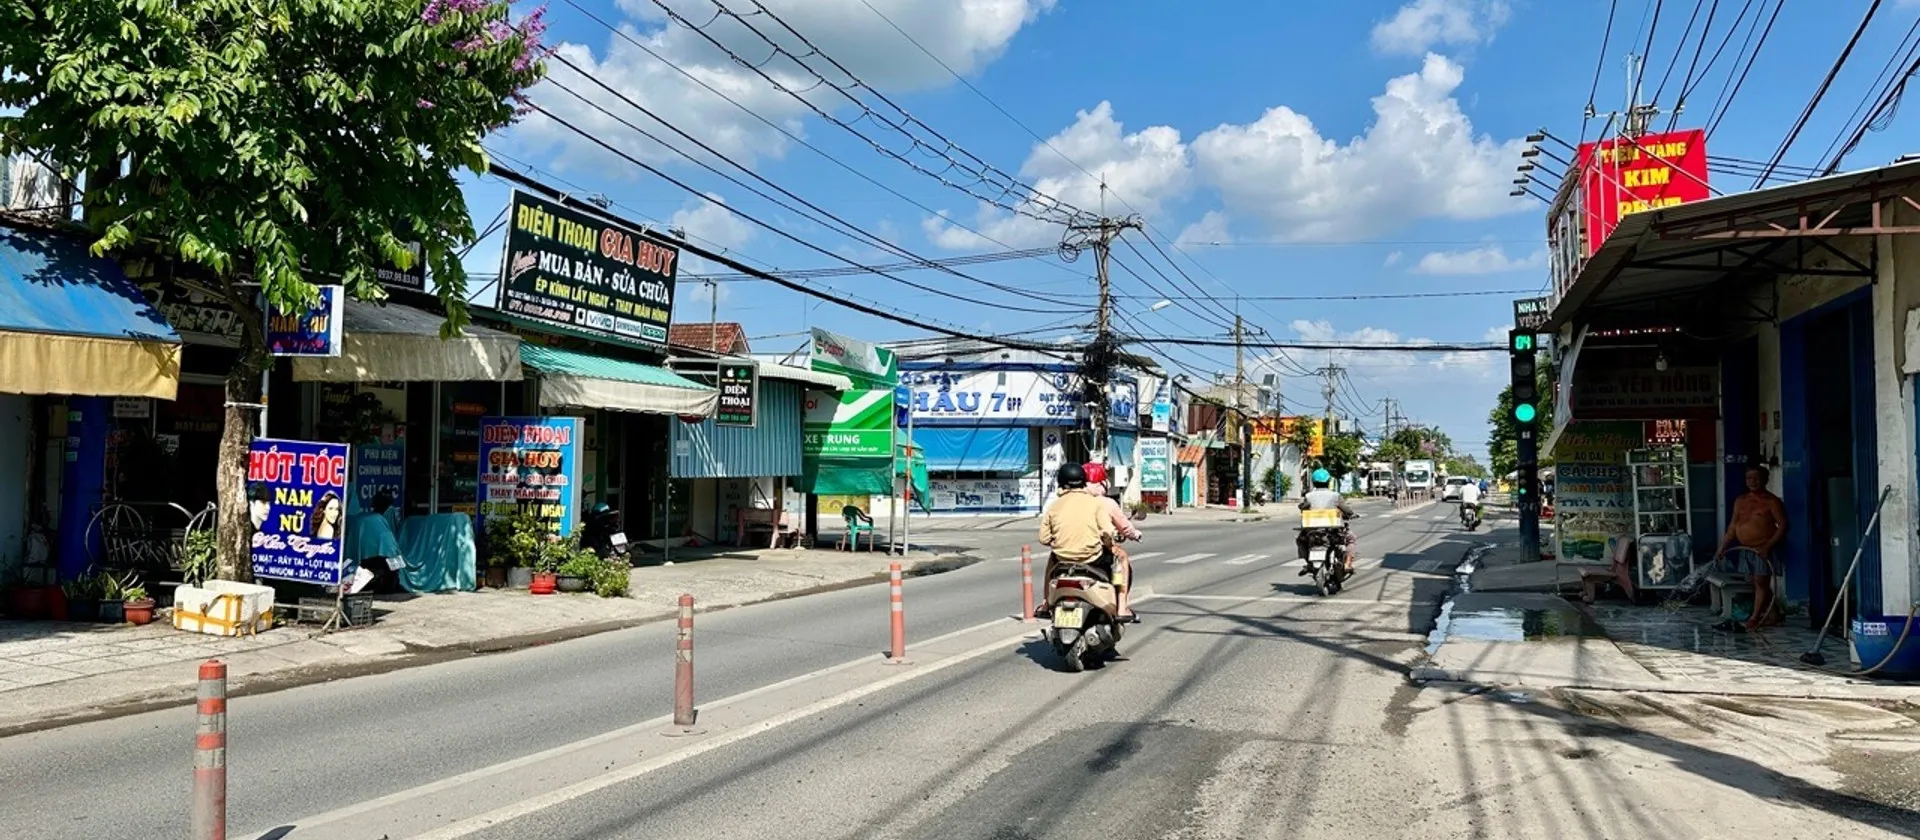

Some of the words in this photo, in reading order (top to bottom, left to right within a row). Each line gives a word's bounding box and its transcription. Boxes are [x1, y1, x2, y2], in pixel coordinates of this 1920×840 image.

[1646, 141, 1687, 159] VÀNG
[1624, 167, 1670, 188] KIM
[517, 203, 555, 242] ĐIỆN
[558, 216, 598, 256] THOẠI
[600, 227, 634, 265] GIA
[637, 240, 676, 277] HUY
[538, 250, 571, 276] MUA
[574, 259, 604, 286] BÁN
[612, 267, 637, 296] SỬA
[639, 278, 670, 305] CHỮA
[535, 276, 548, 293] ÉP
[549, 280, 571, 300] KÍNH
[572, 285, 588, 304] LẤY
[589, 290, 610, 308] NGAY
[616, 298, 634, 316] THAY
[270, 315, 300, 333] NAM
[1515, 334, 1532, 350] 04
[724, 382, 748, 398] ĐIỆN
[721, 396, 750, 408] THOẠI
[990, 391, 1007, 412] 7
[1007, 397, 1022, 412] GPP
[1046, 404, 1074, 417] GPP
[484, 420, 520, 449] ĐIỆN
[524, 424, 571, 450] THOẠI
[804, 434, 819, 444] XE
[820, 433, 860, 445] TRUNG
[489, 451, 519, 467] GIA
[524, 451, 562, 468] HUY
[275, 488, 313, 508] NAM
[490, 488, 512, 499] THAY
[541, 505, 567, 518] NGAY
[279, 511, 307, 534] NỮ
[294, 556, 305, 567] TAI
